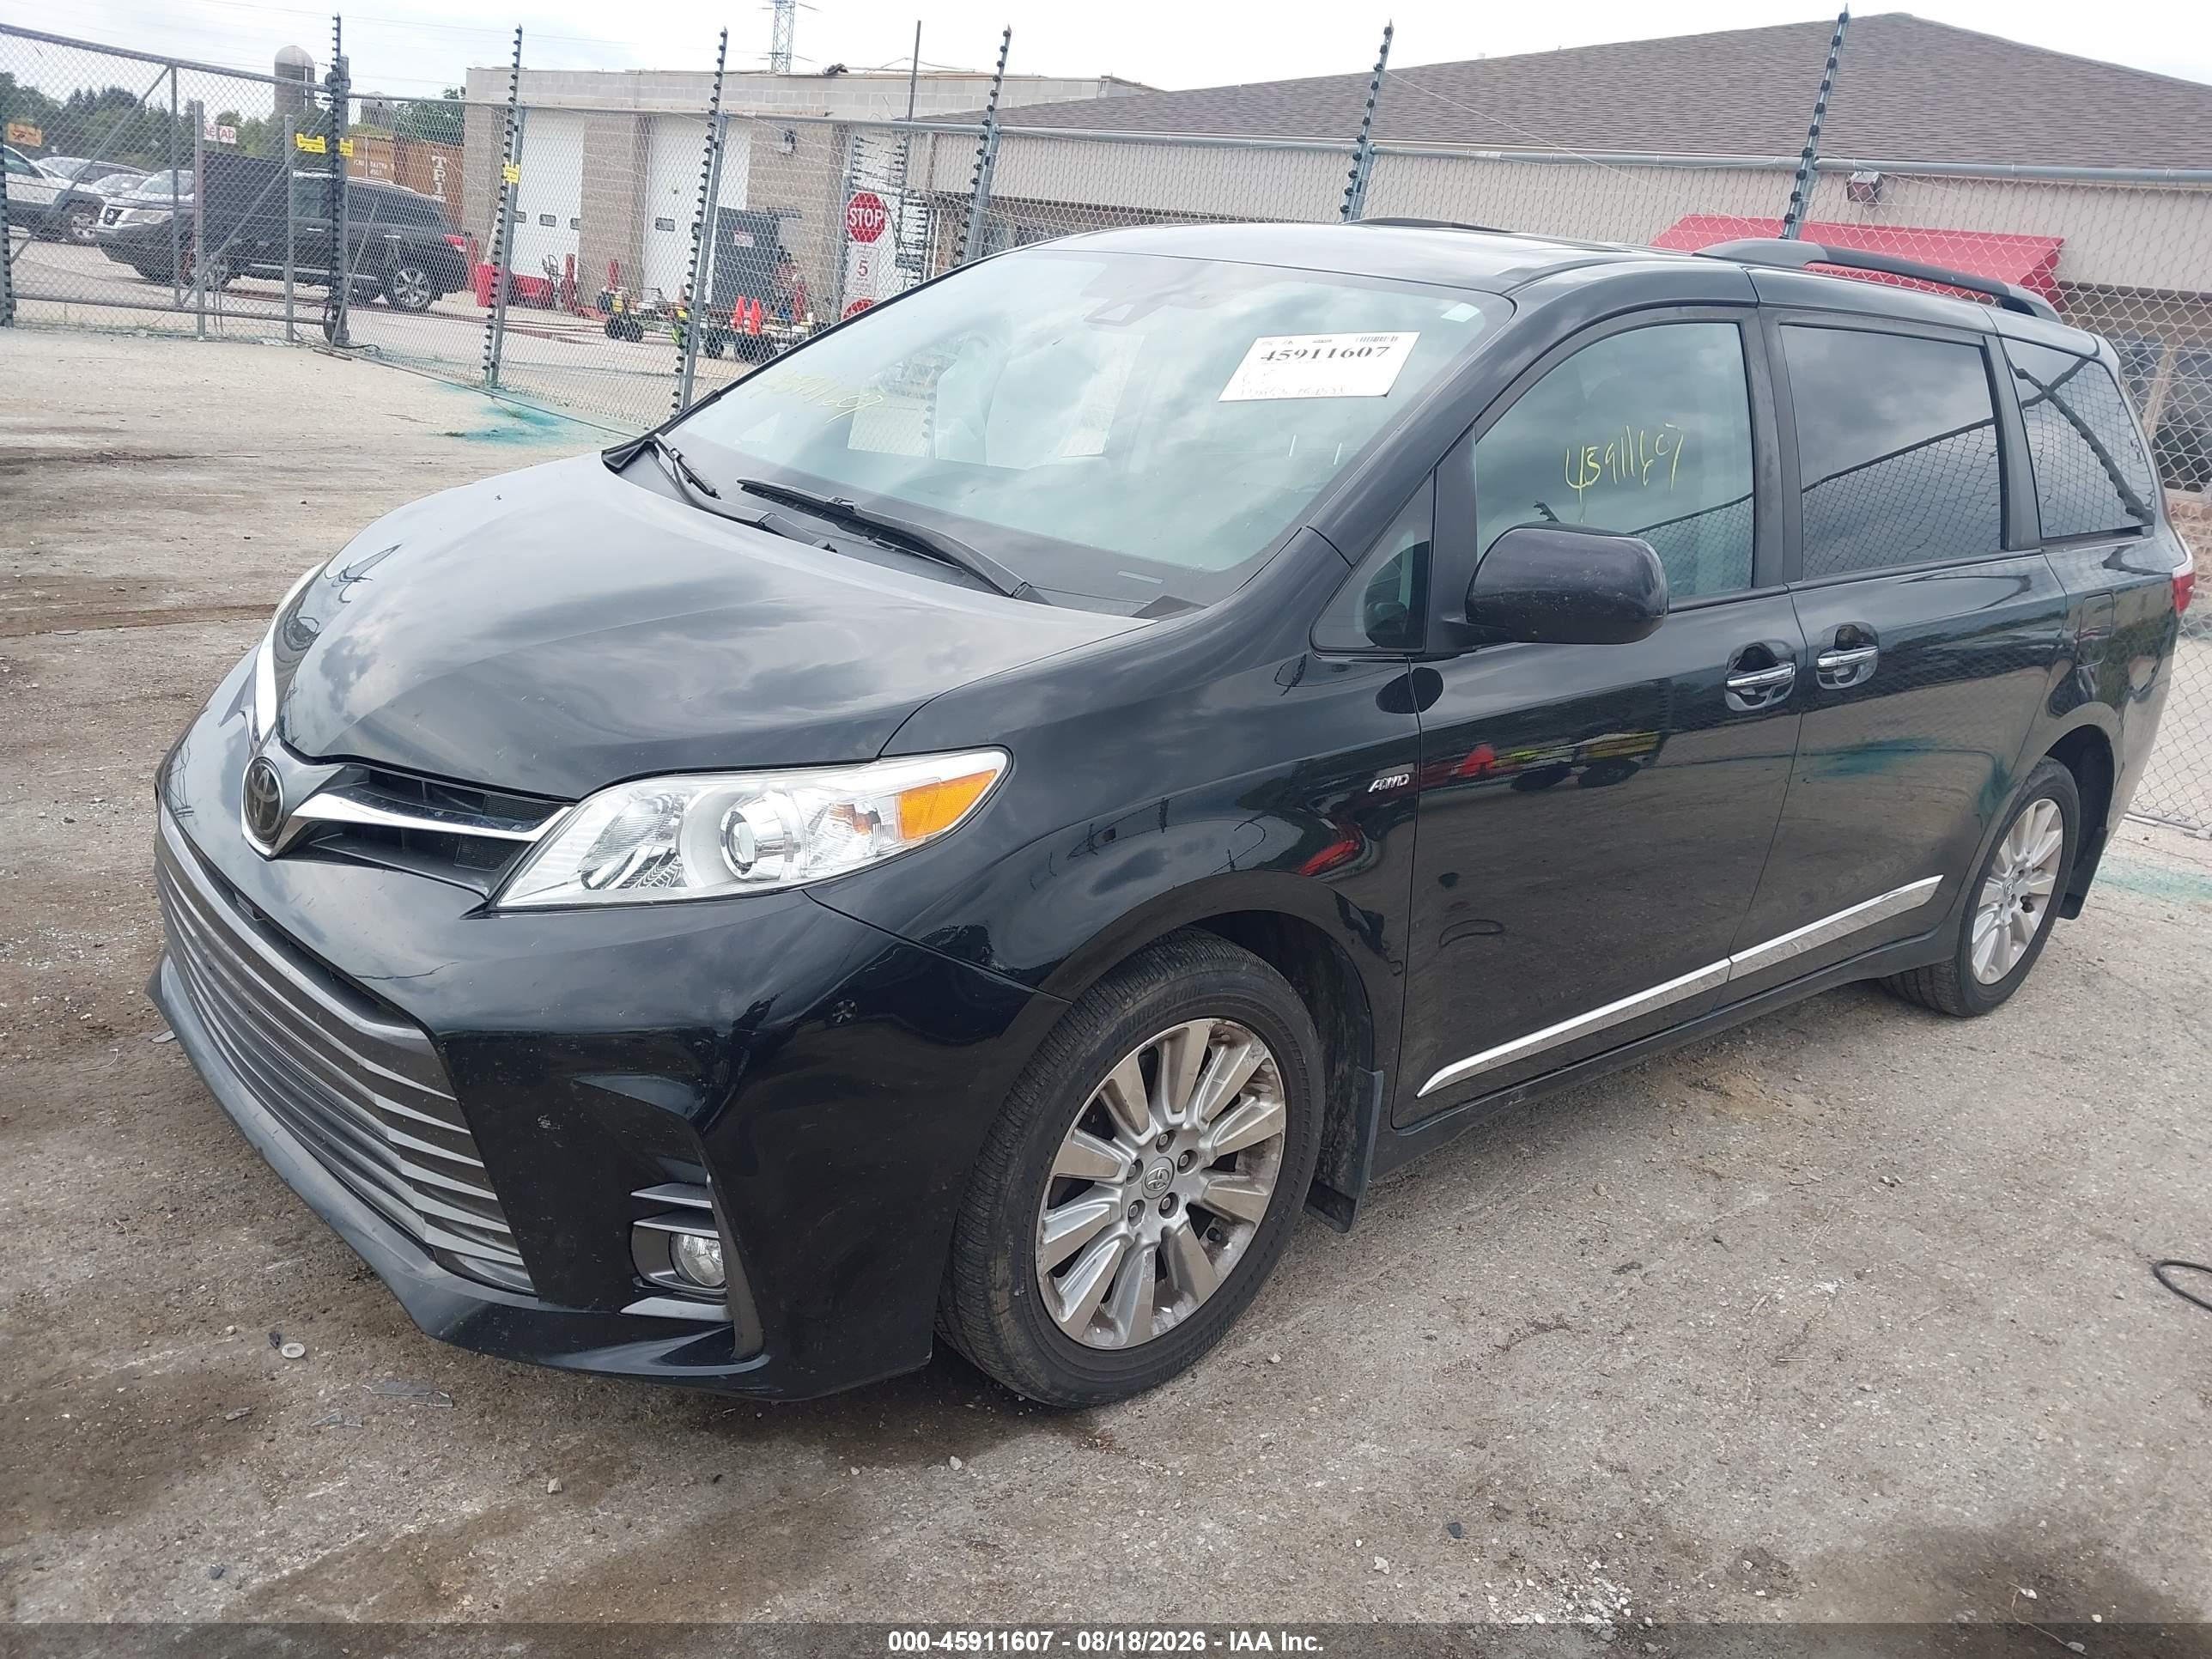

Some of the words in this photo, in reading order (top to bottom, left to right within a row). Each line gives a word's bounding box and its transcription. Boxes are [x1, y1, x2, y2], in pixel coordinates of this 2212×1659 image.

[849, 207, 884, 228] STOP
[857, 260, 869, 276] 5
[1261, 346, 1391, 362] 45911607
[1368, 774, 1410, 793] AWD
